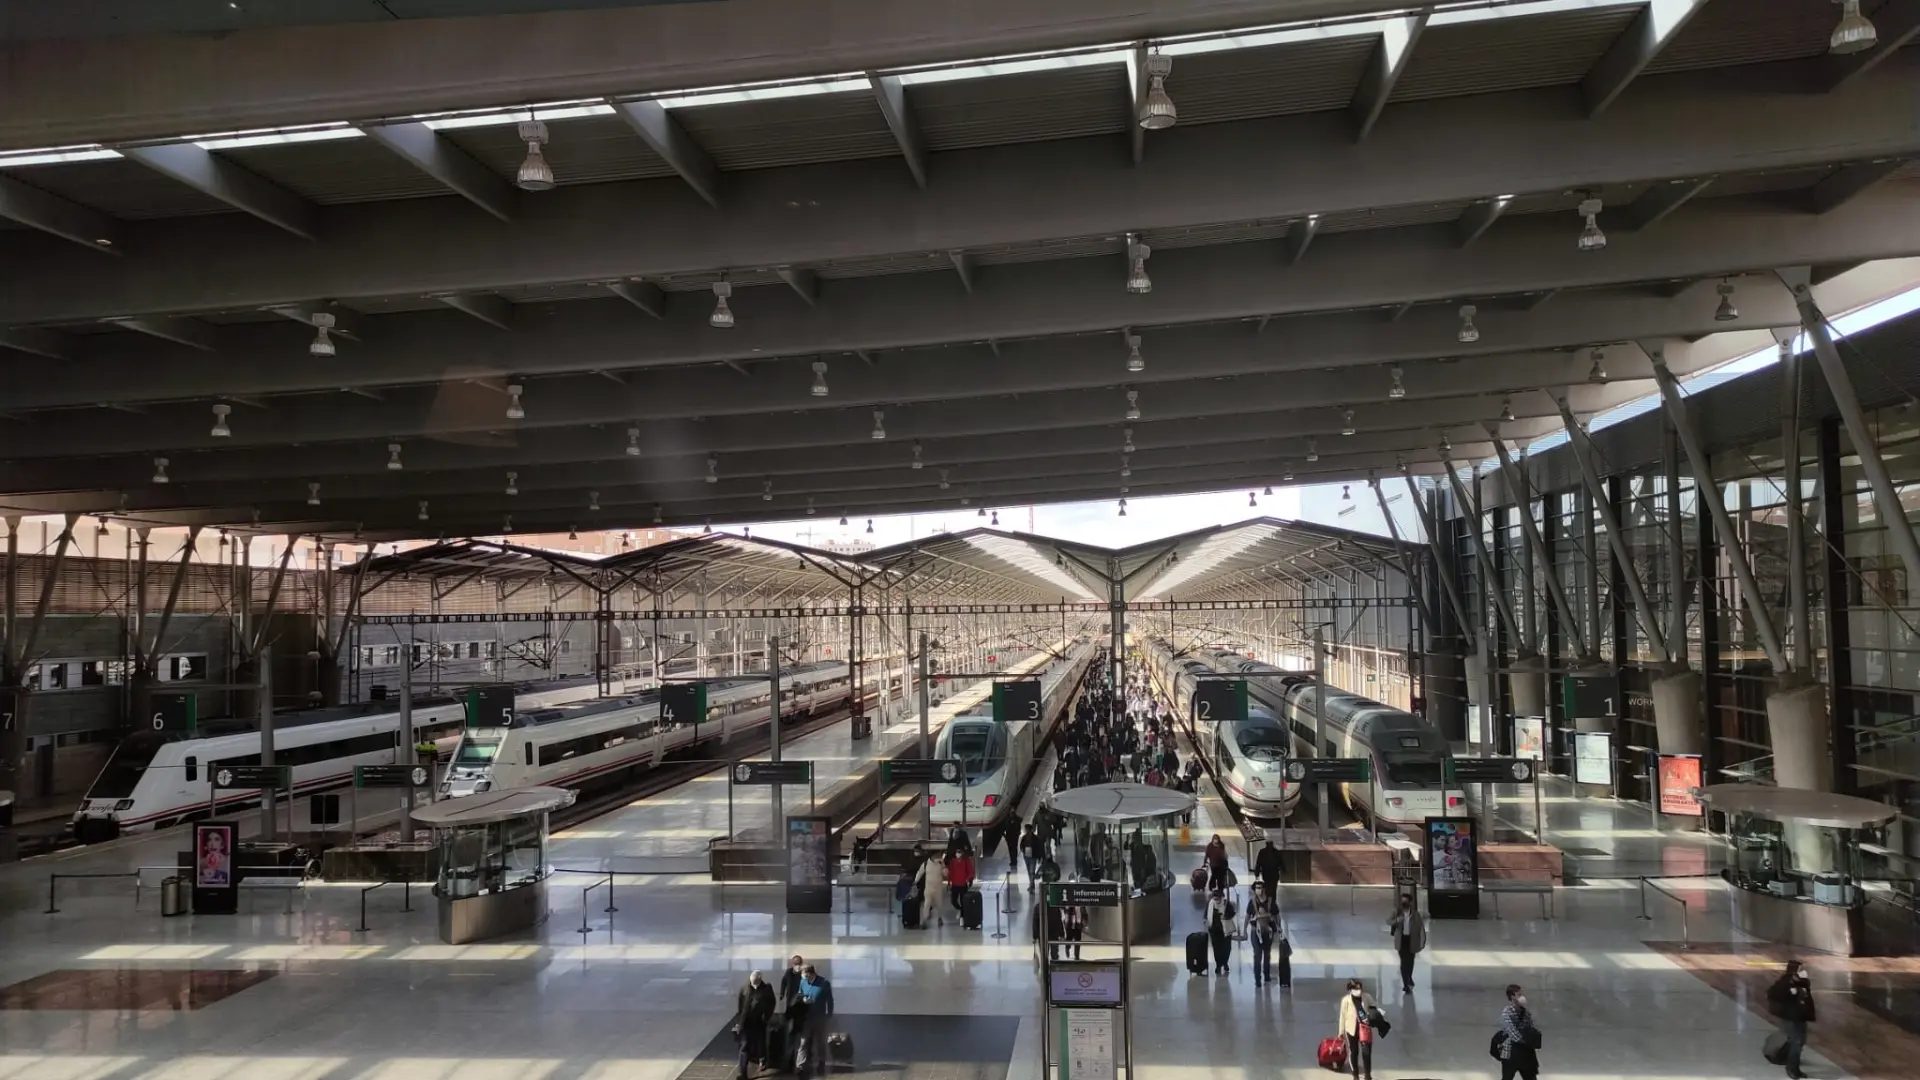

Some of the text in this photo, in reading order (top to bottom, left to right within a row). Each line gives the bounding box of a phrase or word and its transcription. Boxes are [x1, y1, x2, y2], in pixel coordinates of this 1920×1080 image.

[662, 704, 674, 721] 4
[1028, 701, 1039, 719] 3
[1200, 701, 1211, 719] 2
[1604, 697, 1617, 716] 1
[3, 713, 13, 730] 7
[152, 712, 164, 730] 6
[501, 707, 512, 726] 5
